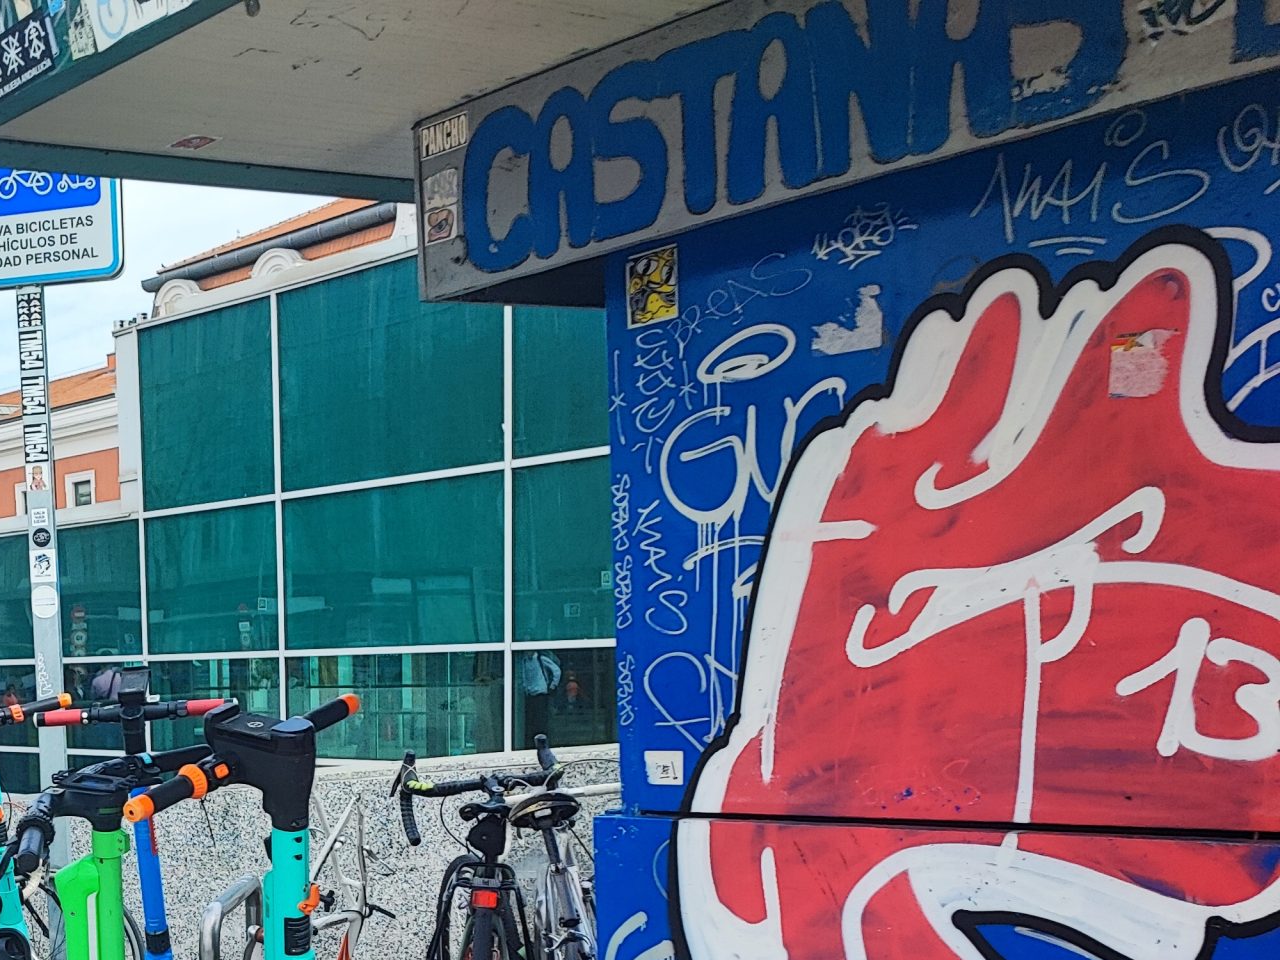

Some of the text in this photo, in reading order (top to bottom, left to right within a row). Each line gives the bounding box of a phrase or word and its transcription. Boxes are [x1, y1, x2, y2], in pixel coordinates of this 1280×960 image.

[422, 114, 467, 157] PANCHO
[16, 214, 94, 236] BICICLETAS
[60, 232, 78, 246] DE
[26, 247, 99, 266] PERSONAL
